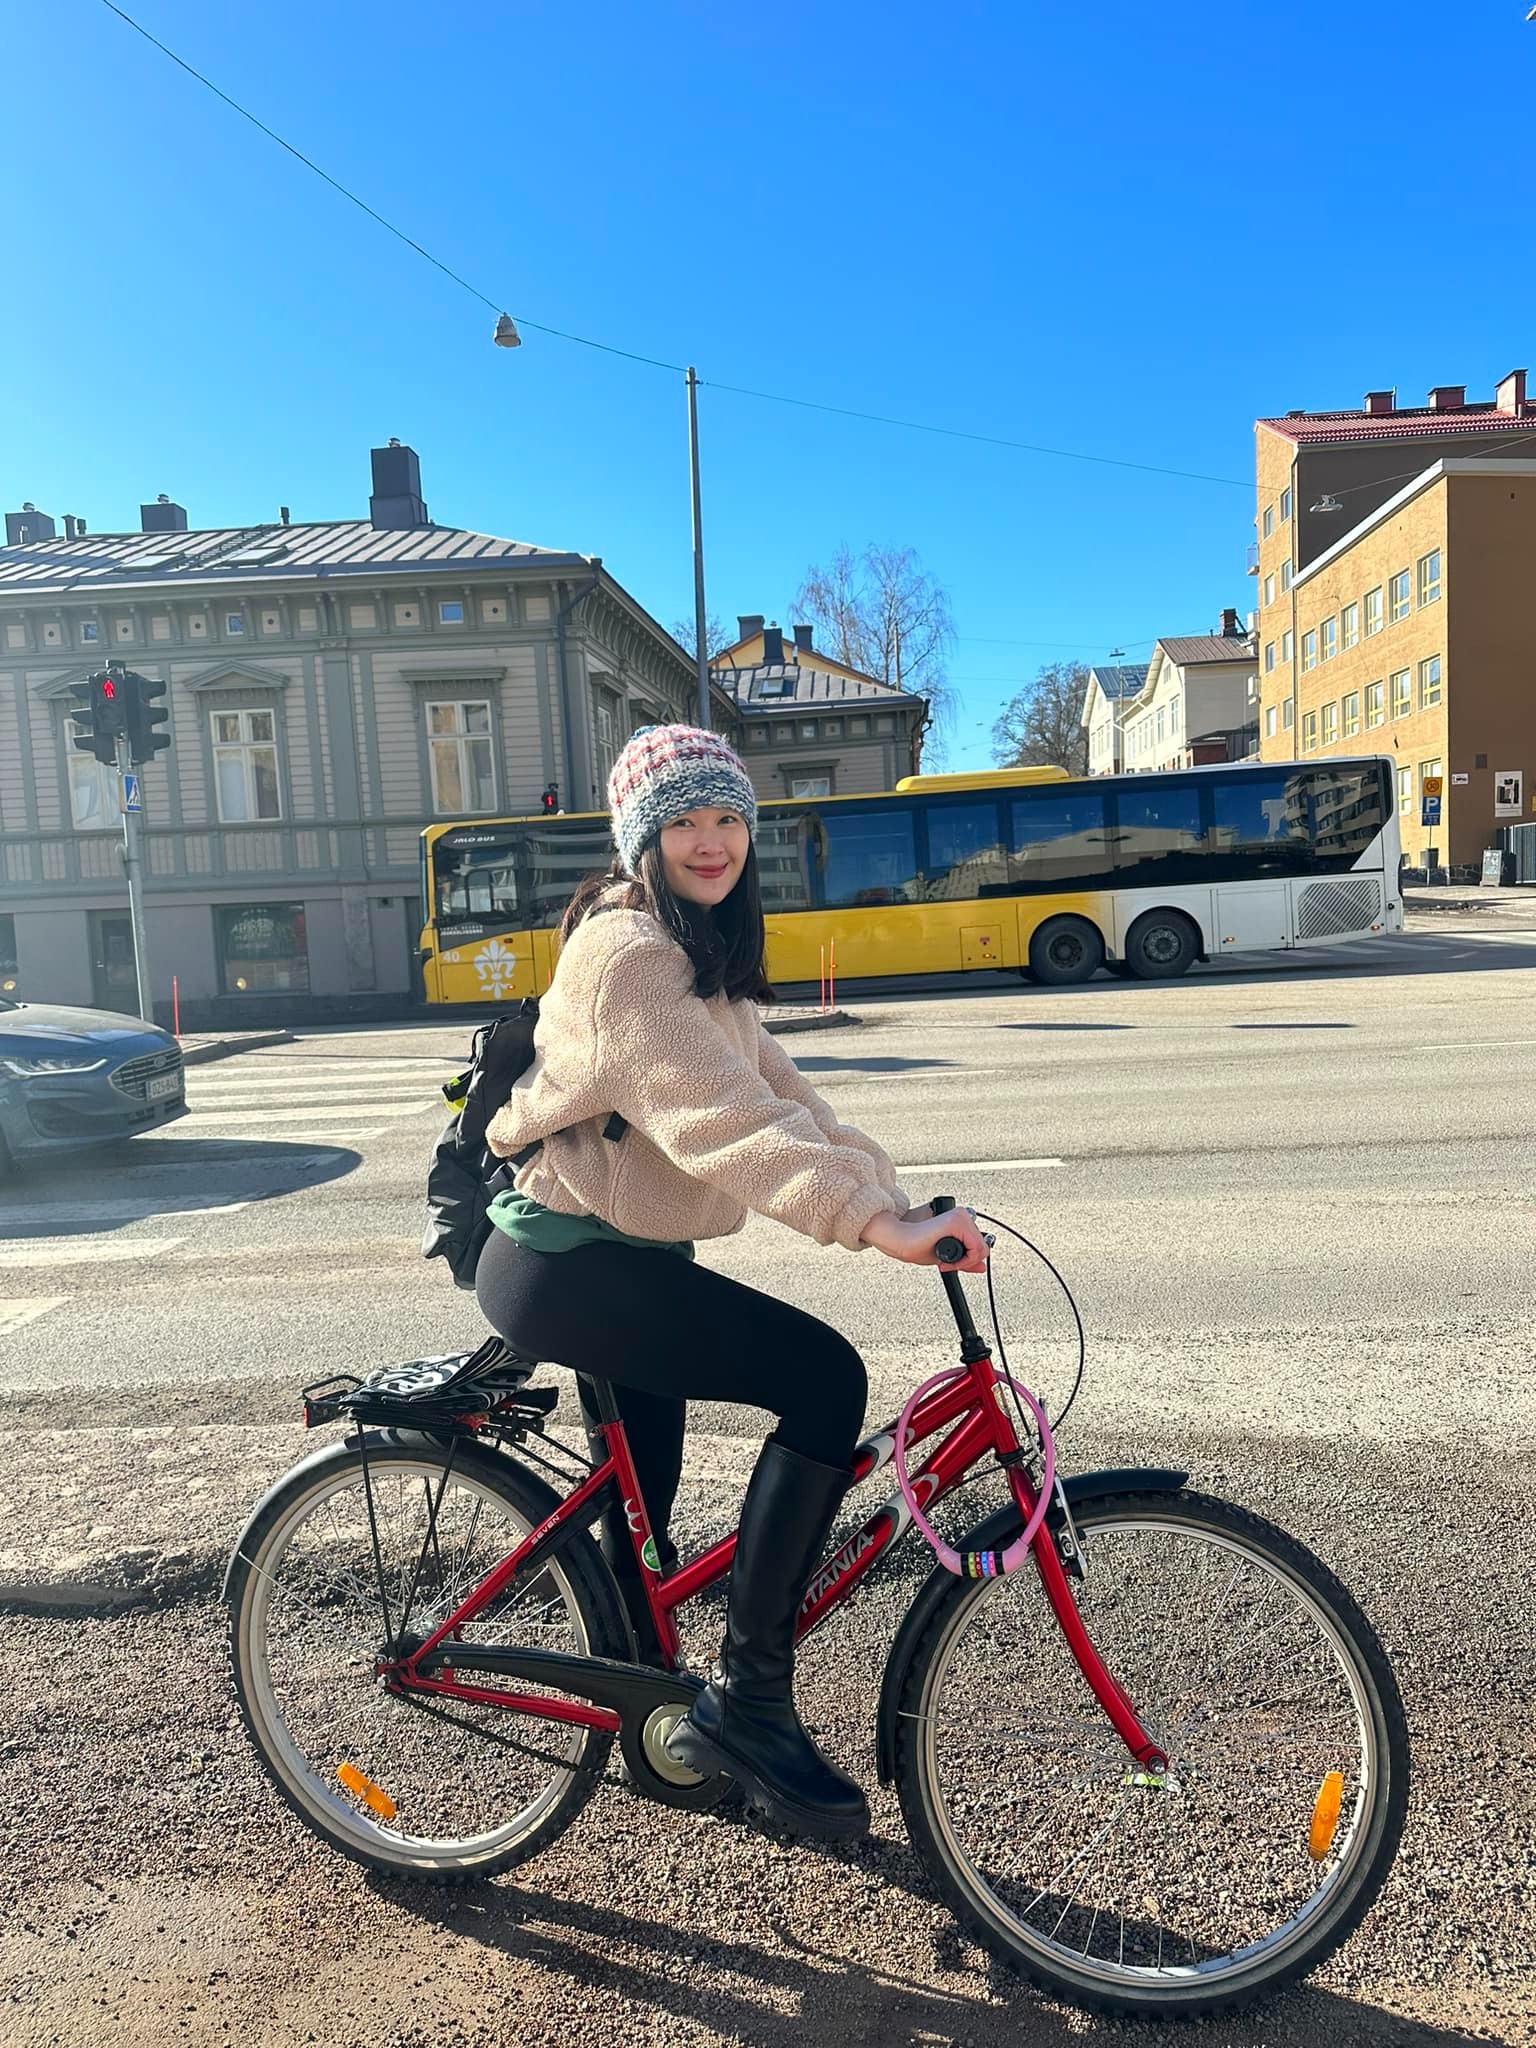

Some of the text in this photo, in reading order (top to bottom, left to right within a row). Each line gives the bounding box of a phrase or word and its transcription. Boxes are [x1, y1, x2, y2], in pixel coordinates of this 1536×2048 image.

[1426, 797, 1439, 812] P
[442, 951, 460, 962] 40
[530, 1514, 560, 1545] SEVEN
[801, 1531, 875, 1614] ITANIA
